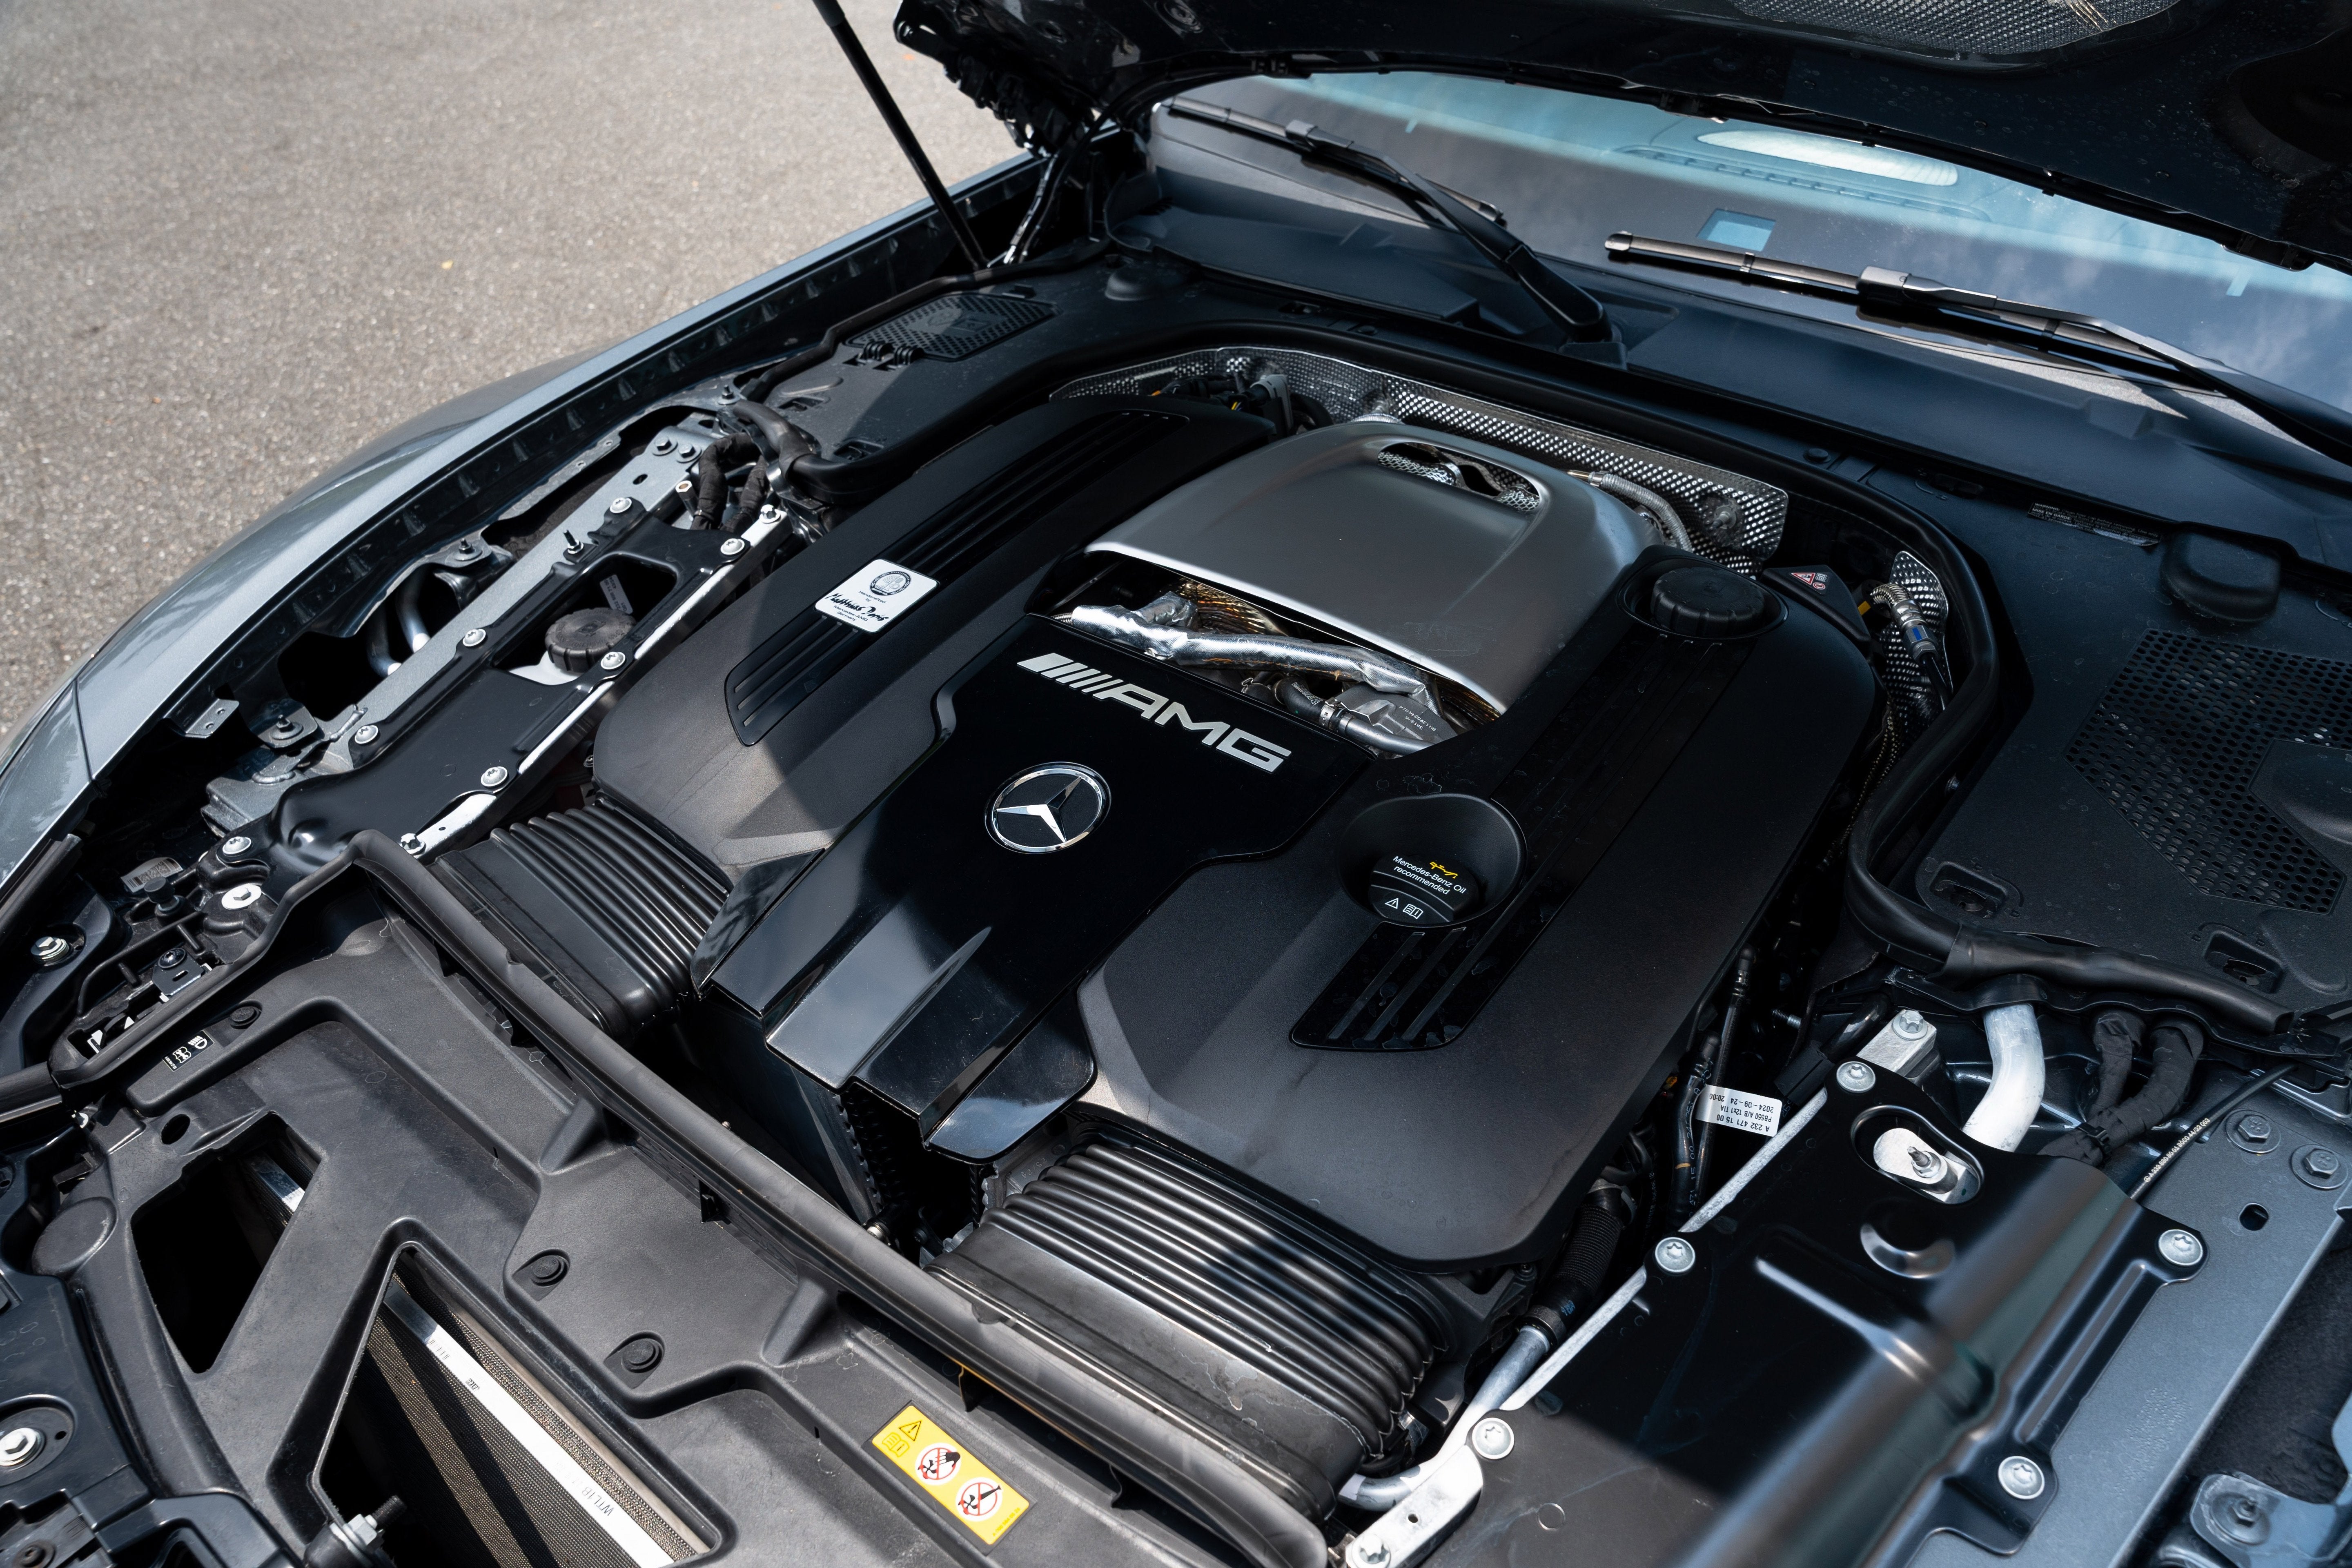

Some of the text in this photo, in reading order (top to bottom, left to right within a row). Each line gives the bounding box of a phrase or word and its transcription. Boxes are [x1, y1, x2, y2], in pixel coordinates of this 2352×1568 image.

[858, 591, 886, 604] Handcrafted
[833, 605, 869, 621] Mercedes-AMG
[837, 611, 857, 621] Germany
[1392, 855, 1467, 893] Mercedes-Benz Oil
[1394, 866, 1450, 895] recommended
[1737, 1119, 1748, 1127] 471
[1755, 1113, 1772, 1123] PB550
[1750, 1122, 1763, 1131] 232
